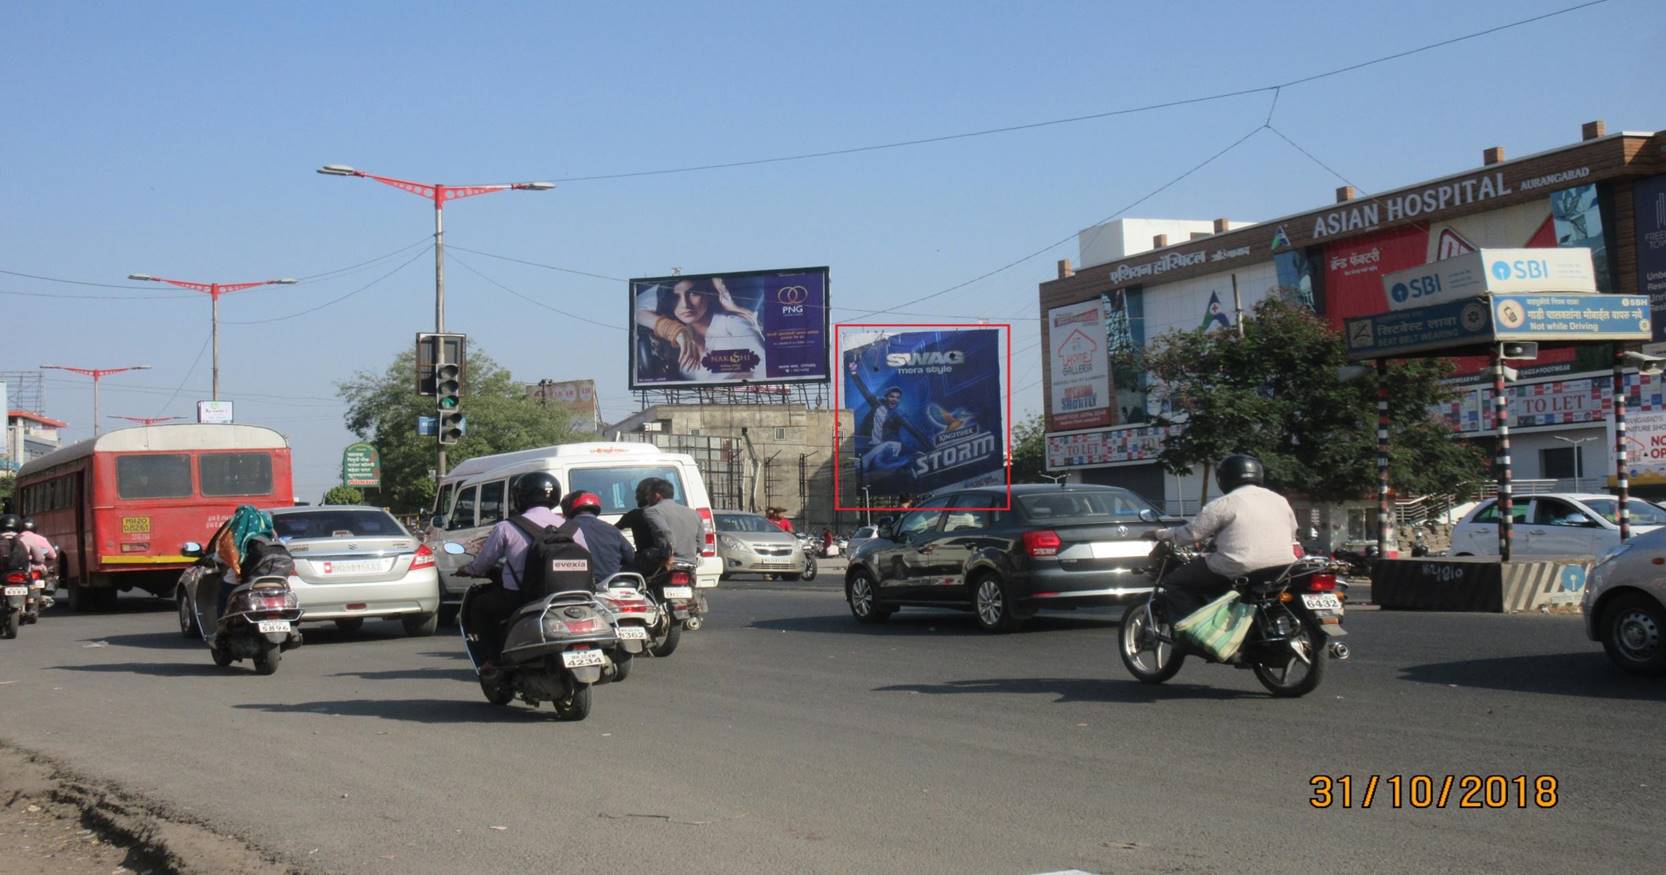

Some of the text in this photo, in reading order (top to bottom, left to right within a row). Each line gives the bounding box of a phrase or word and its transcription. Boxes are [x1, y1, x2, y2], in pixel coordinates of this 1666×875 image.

[1313, 167, 1590, 239] ASIAN HOSPITAL AURANGABAD
[1513, 259, 1549, 279] SBI
[1408, 273, 1442, 299] SBI
[782, 305, 804, 314] PNG
[1530, 322, 1600, 333] Not while Driving
[886, 350, 965, 368] SWAG
[898, 366, 953, 375] mera style
[1523, 394, 1586, 414] TO LET
[915, 434, 995, 475] STORM
[1306, 600, 1339, 609] 6432
[567, 657, 602, 667] 4234
